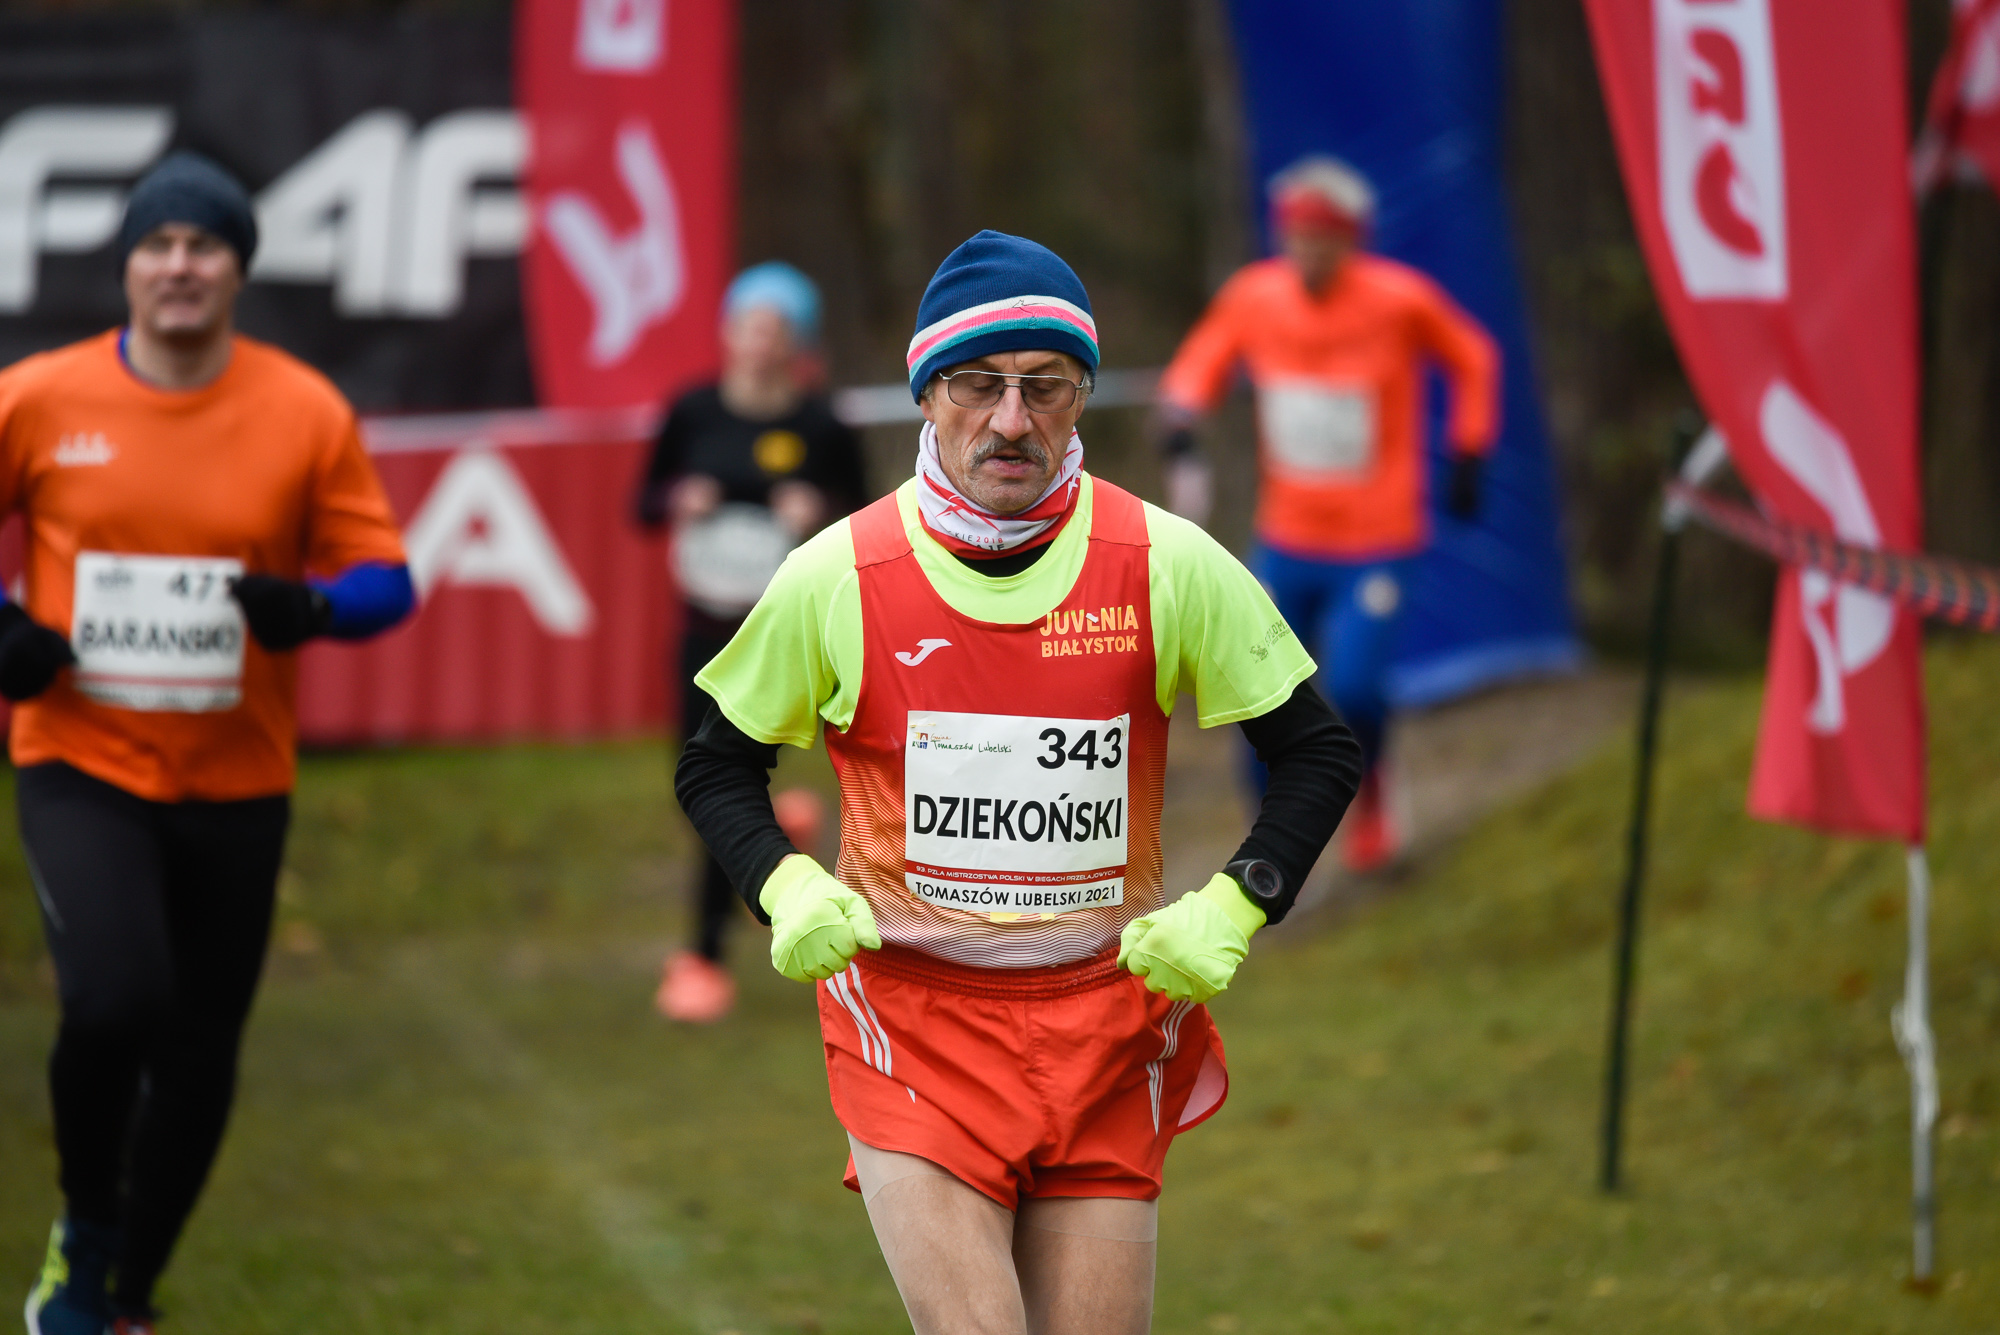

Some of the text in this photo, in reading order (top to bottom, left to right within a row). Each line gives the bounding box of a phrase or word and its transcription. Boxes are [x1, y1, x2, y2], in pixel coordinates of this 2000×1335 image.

[976, 536, 1004, 544] 2018
[1041, 635, 1139, 657] BIAŁYSTOK
[978, 741, 1012, 753] Lubelski
[1036, 727, 1122, 770] 343
[914, 793, 1122, 842] DZIEKOŃSKI
[928, 868, 945, 877] PZLA
[946, 871, 998, 880] MISTRZOSTWA
[915, 881, 1115, 906] TOMASZÓW LUBELSKI 2021
